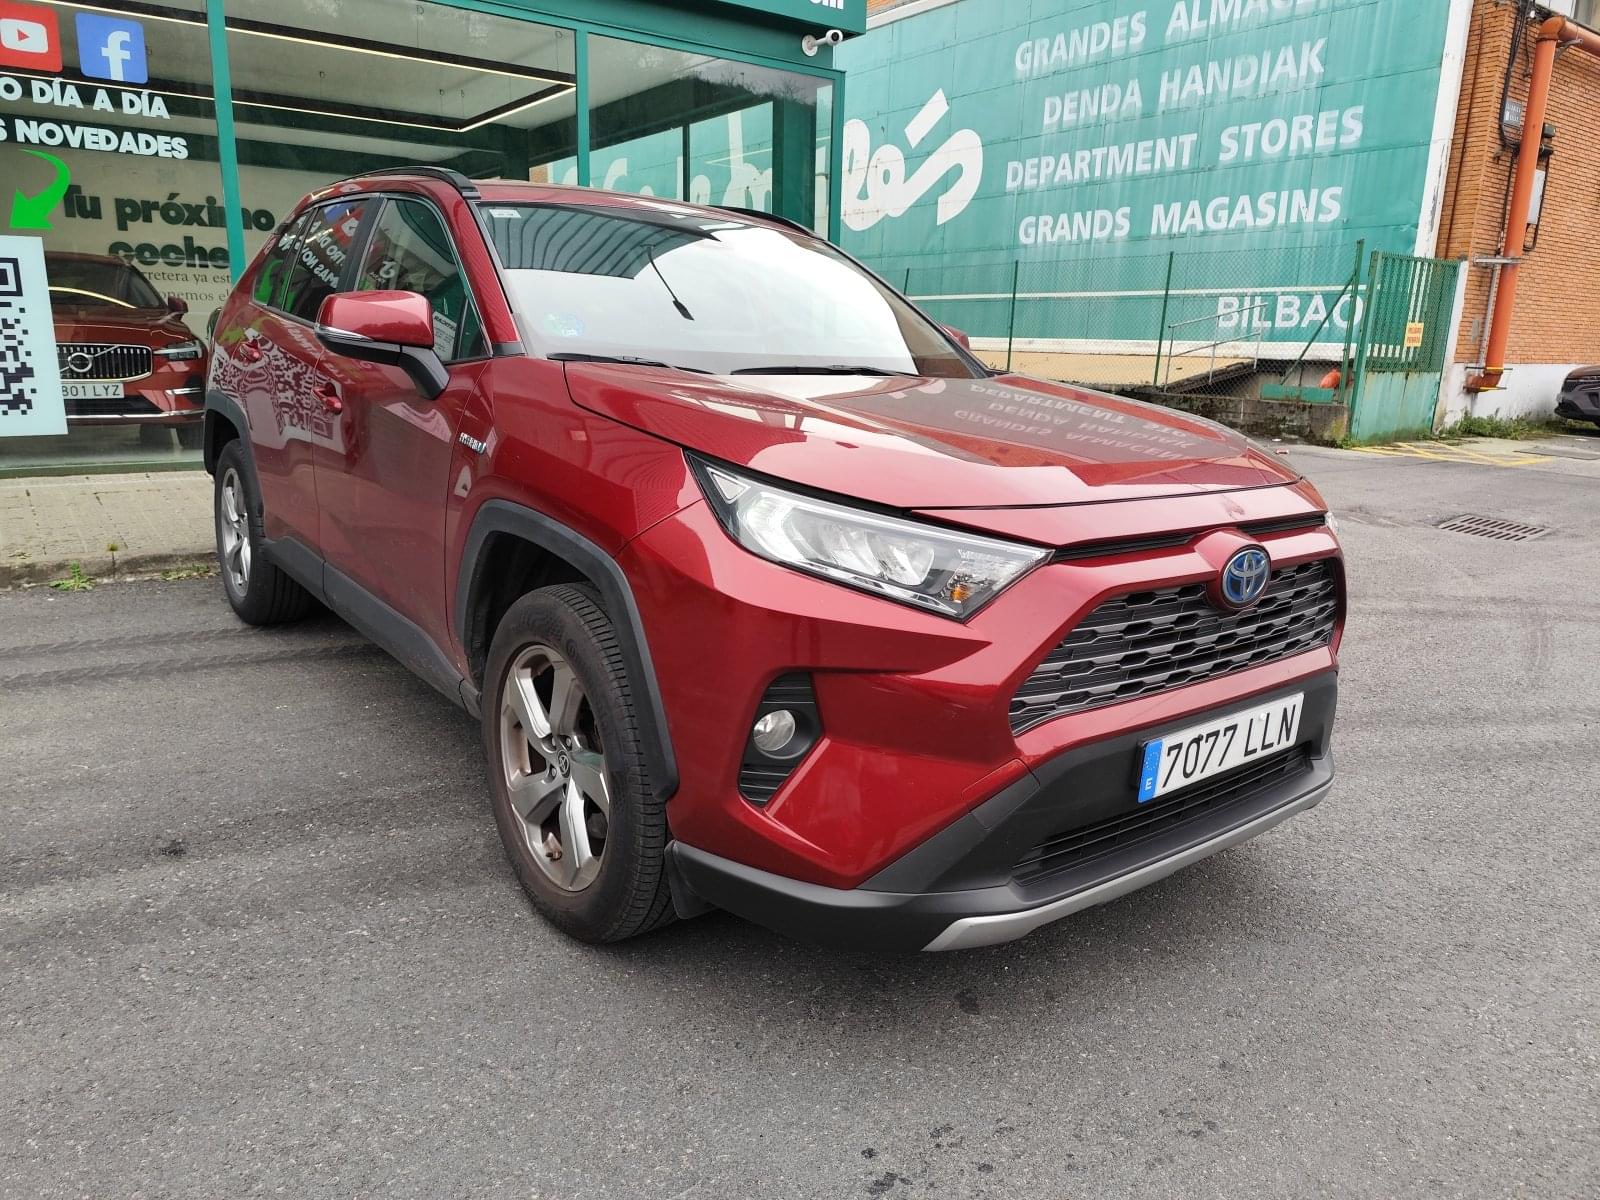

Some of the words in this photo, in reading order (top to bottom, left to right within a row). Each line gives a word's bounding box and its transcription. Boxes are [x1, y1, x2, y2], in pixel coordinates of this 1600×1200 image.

[1015, 10, 1147, 71] GRANDES
[1166, 0, 1322, 37] ALM
[31, 77, 84, 109] DÍA
[93, 88, 115, 113] A
[122, 91, 170, 120] DÍA
[1043, 78, 1143, 126] DENDA
[1159, 37, 1328, 105] HANDIAK
[15, 118, 189, 160] NOVEDADES
[1006, 133, 1197, 192] DEPARTMENT
[1219, 105, 1364, 161] STORES
[1018, 207, 1131, 245] GRANDS
[1151, 186, 1343, 235] MAGASINS
[193, 273, 208, 286] ya
[1217, 294, 1364, 329] BILBAO
[93, 385, 121, 397] LYZ
[1162, 723, 1238, 788] 7077
[1243, 703, 1297, 757] LLN
